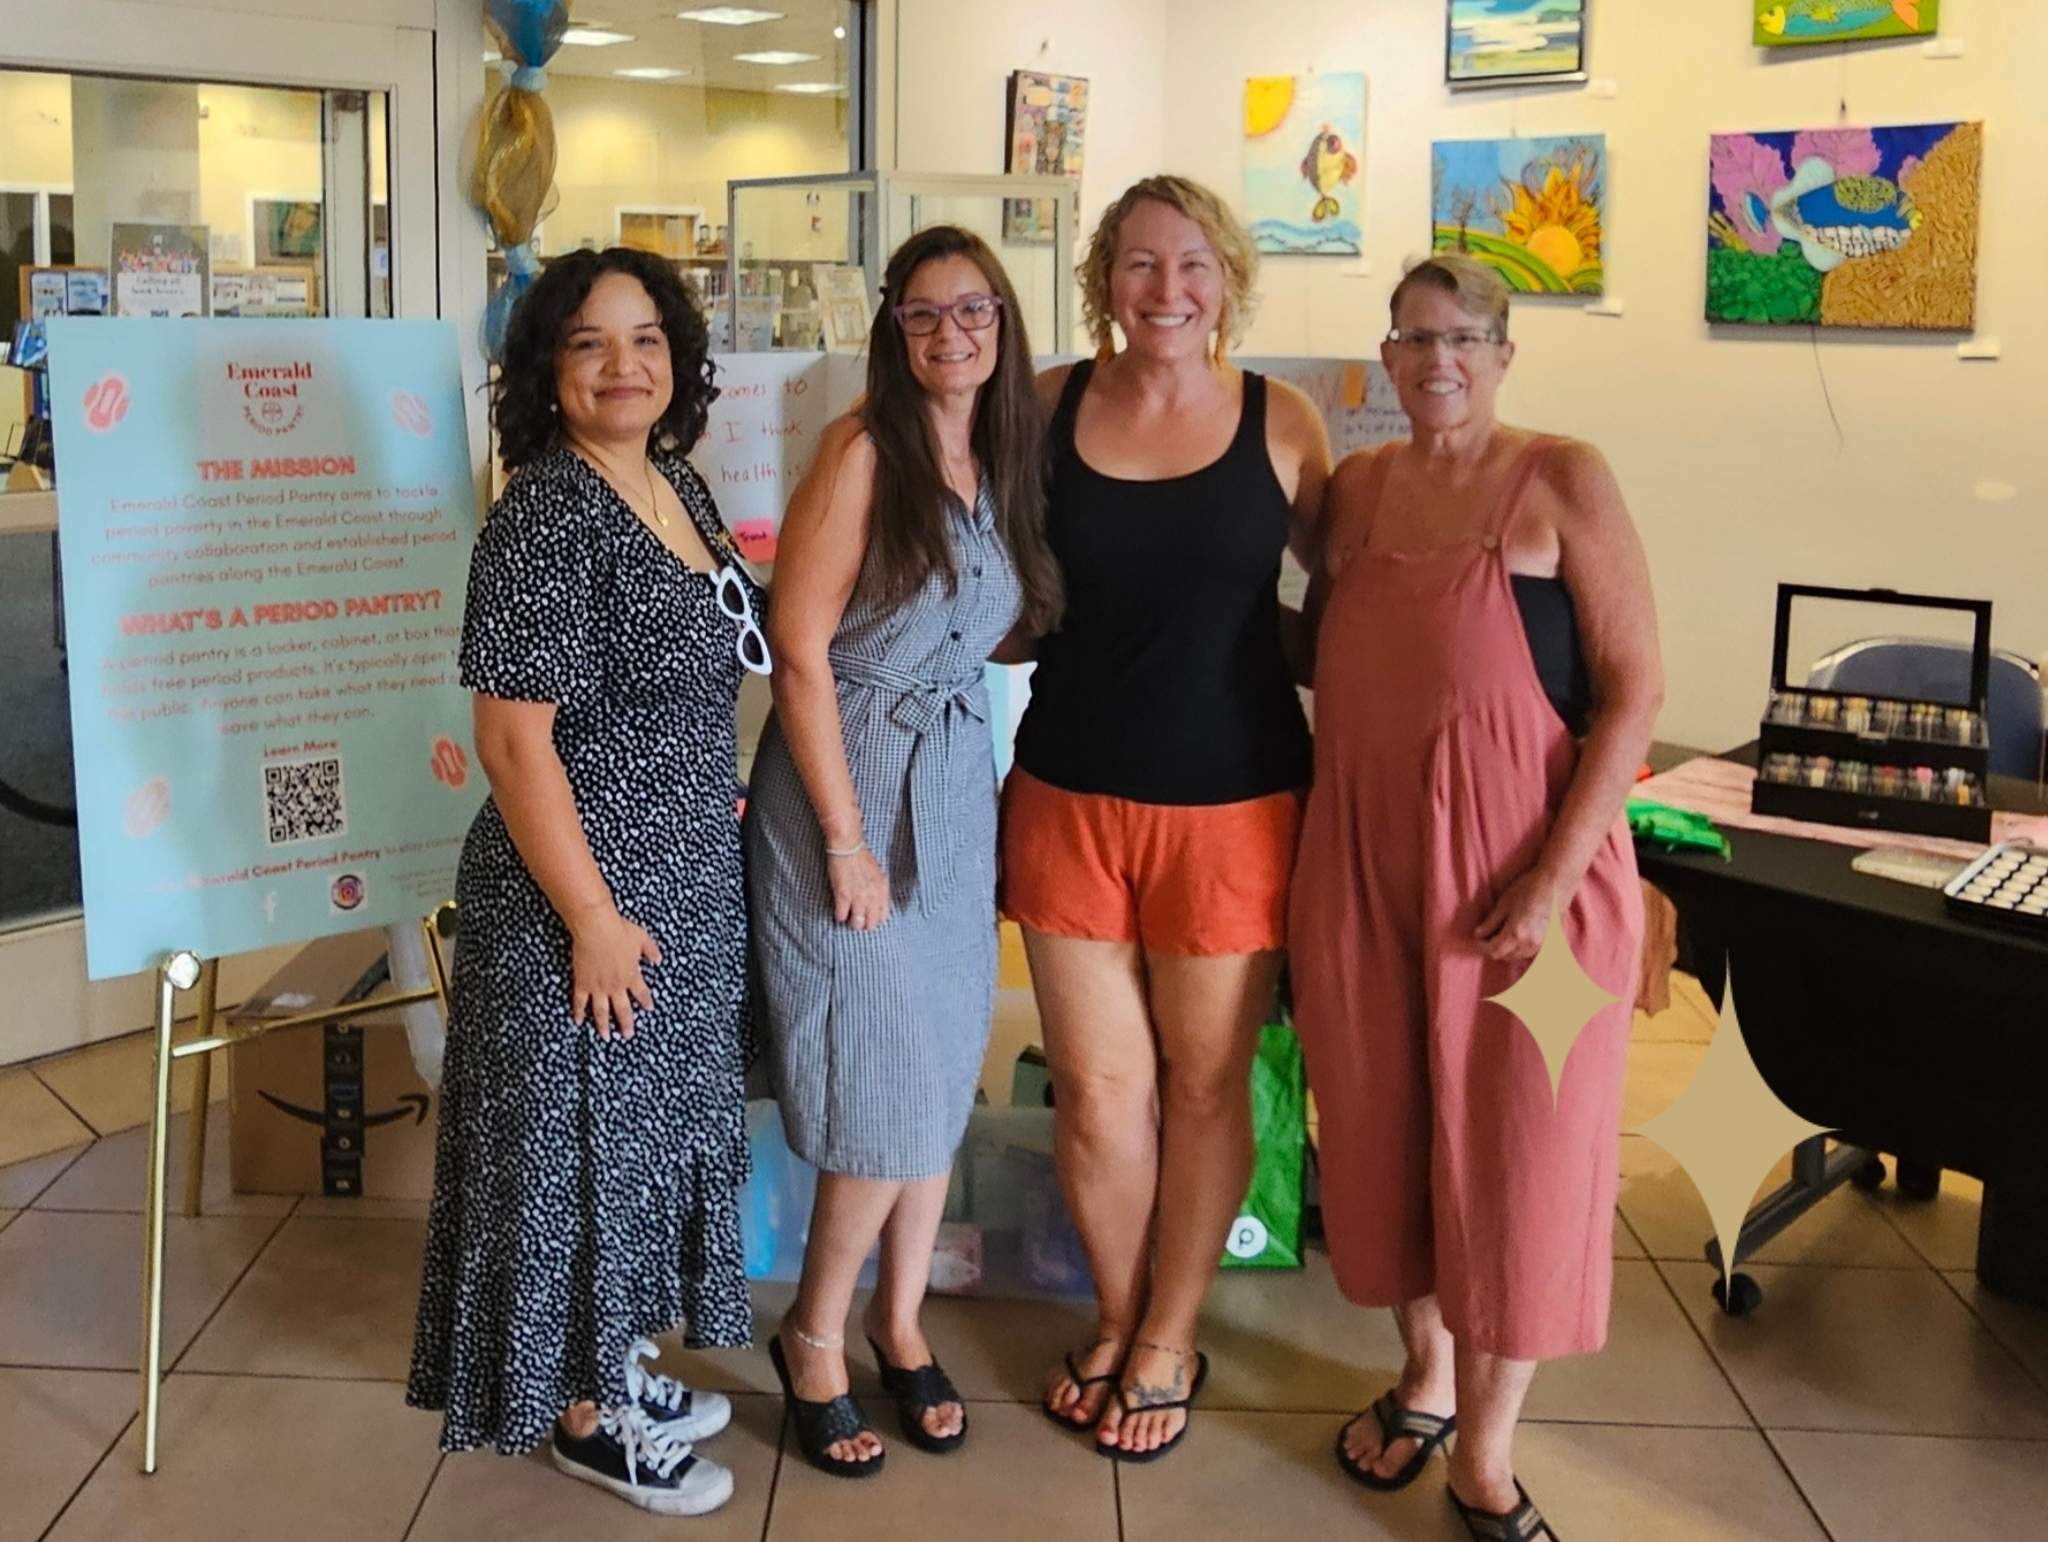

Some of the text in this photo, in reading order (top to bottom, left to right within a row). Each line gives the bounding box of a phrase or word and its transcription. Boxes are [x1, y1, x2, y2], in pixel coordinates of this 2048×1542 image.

[227, 361, 312, 379] Emerald
[244, 382, 297, 398] Coast
[784, 377, 809, 396] to
[197, 456, 356, 480] THE MISSION
[721, 464, 777, 483] health
[111, 484, 438, 513] Emerald Coast Period Pantry aims to tackle
[164, 520, 223, 537] poverty
[228, 519, 242, 530] in
[247, 514, 271, 529] the
[276, 512, 337, 528] Emerald
[341, 510, 384, 525] Coast
[389, 507, 442, 524] through
[184, 541, 288, 560] collaboration
[294, 537, 322, 551] and
[326, 531, 408, 548] established
[412, 528, 457, 547] period
[149, 571, 214, 589] pantries
[219, 566, 264, 584] along
[268, 562, 292, 577] the
[296, 559, 358, 576] Emerald
[120, 588, 442, 637] WHAT'S A PERIOD PANTRY?
[180, 649, 229, 666] pantry
[234, 646, 247, 658] is
[251, 646, 263, 658] a
[385, 632, 399, 644] or
[404, 628, 429, 641] box
[434, 626, 461, 638] that
[152, 675, 186, 690] free
[191, 668, 242, 690] period
[348, 652, 407, 673] typically
[411, 652, 447, 667] open
[264, 690, 292, 705] can
[298, 687, 331, 700] take
[336, 682, 372, 695] what
[376, 678, 405, 695] they
[410, 673, 447, 687] need
[264, 711, 300, 729] what
[307, 708, 339, 726] they
[264, 740, 337, 758] Learn More
[252, 861, 292, 877] Coast
[296, 853, 338, 869] Period
[342, 849, 380, 862] Pantry
